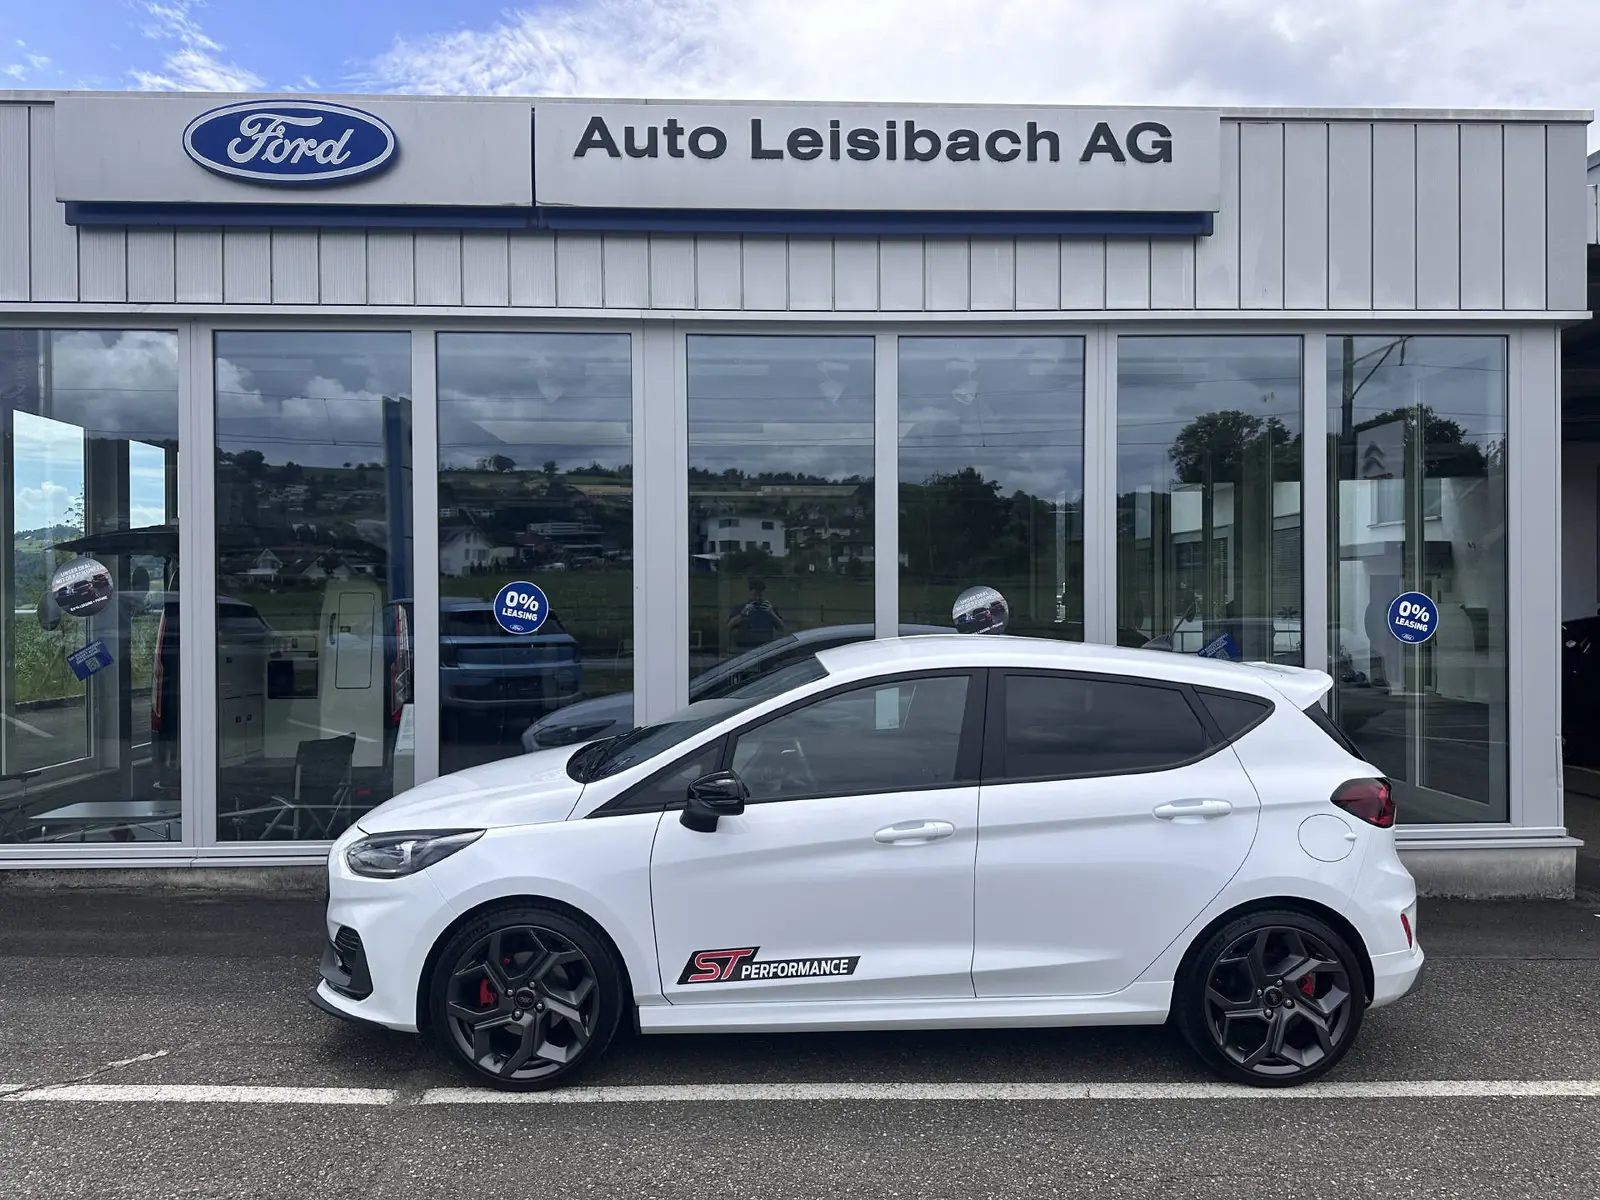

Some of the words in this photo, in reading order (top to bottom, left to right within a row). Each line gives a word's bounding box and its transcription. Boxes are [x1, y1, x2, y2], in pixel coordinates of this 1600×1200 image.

[227, 113, 353, 164] Ford
[573, 116, 728, 159] Auto
[750, 119, 1061, 162] Leisibach
[1078, 122, 1174, 163] AG
[505, 591, 539, 611] 0%
[1399, 601, 1430, 622] 0%
[502, 607, 538, 621] LEASING
[1395, 616, 1428, 632] LEASING
[687, 949, 754, 982] ST
[741, 959, 849, 979] PERFORMANCE
